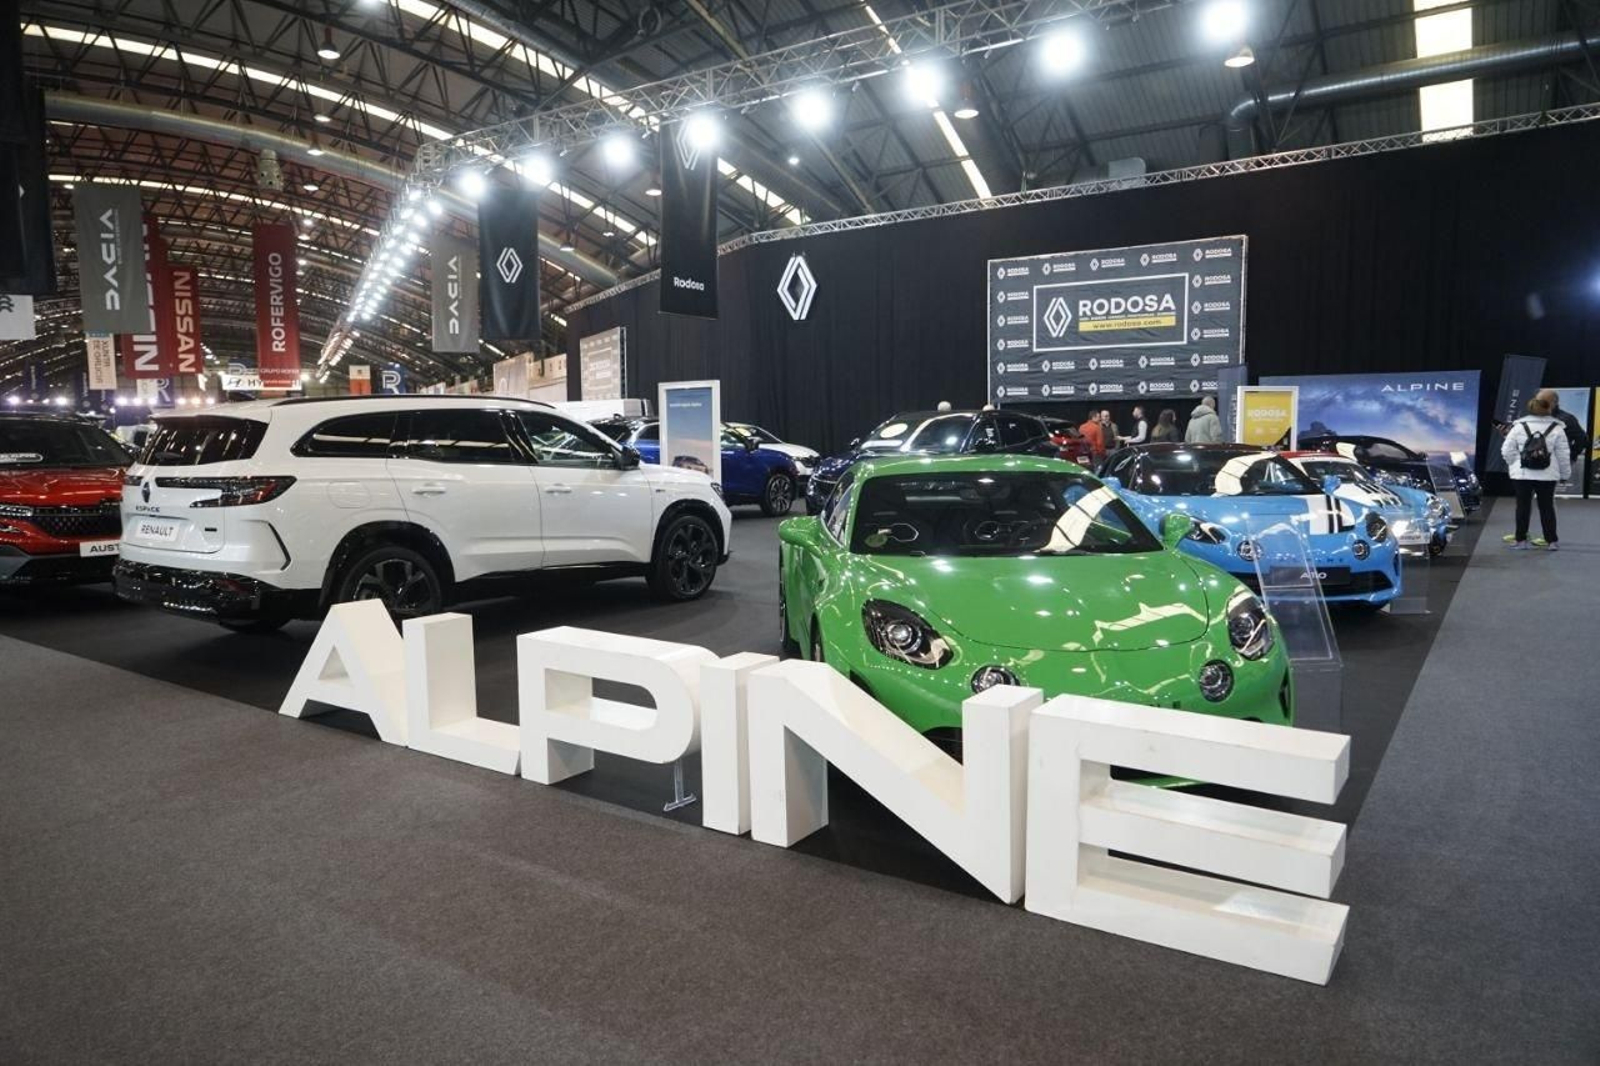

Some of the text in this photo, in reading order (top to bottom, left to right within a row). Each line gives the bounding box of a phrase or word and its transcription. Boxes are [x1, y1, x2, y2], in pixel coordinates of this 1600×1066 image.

[100, 209, 120, 311] DACIA
[447, 255, 460, 335] DACIA
[673, 276, 705, 291] Rodosa
[268, 252, 286, 352] ROFERVIGO
[1079, 293, 1176, 317] RODOSA
[173, 271, 196, 372] NISSAN
[1093, 319, 1162, 330] www.rodosa.com
[1381, 382, 1465, 392] ALPINE
[136, 505, 161, 513] ESPACE
[142, 524, 174, 537] RENAULT
[278, 598, 1352, 986] ALPINE
